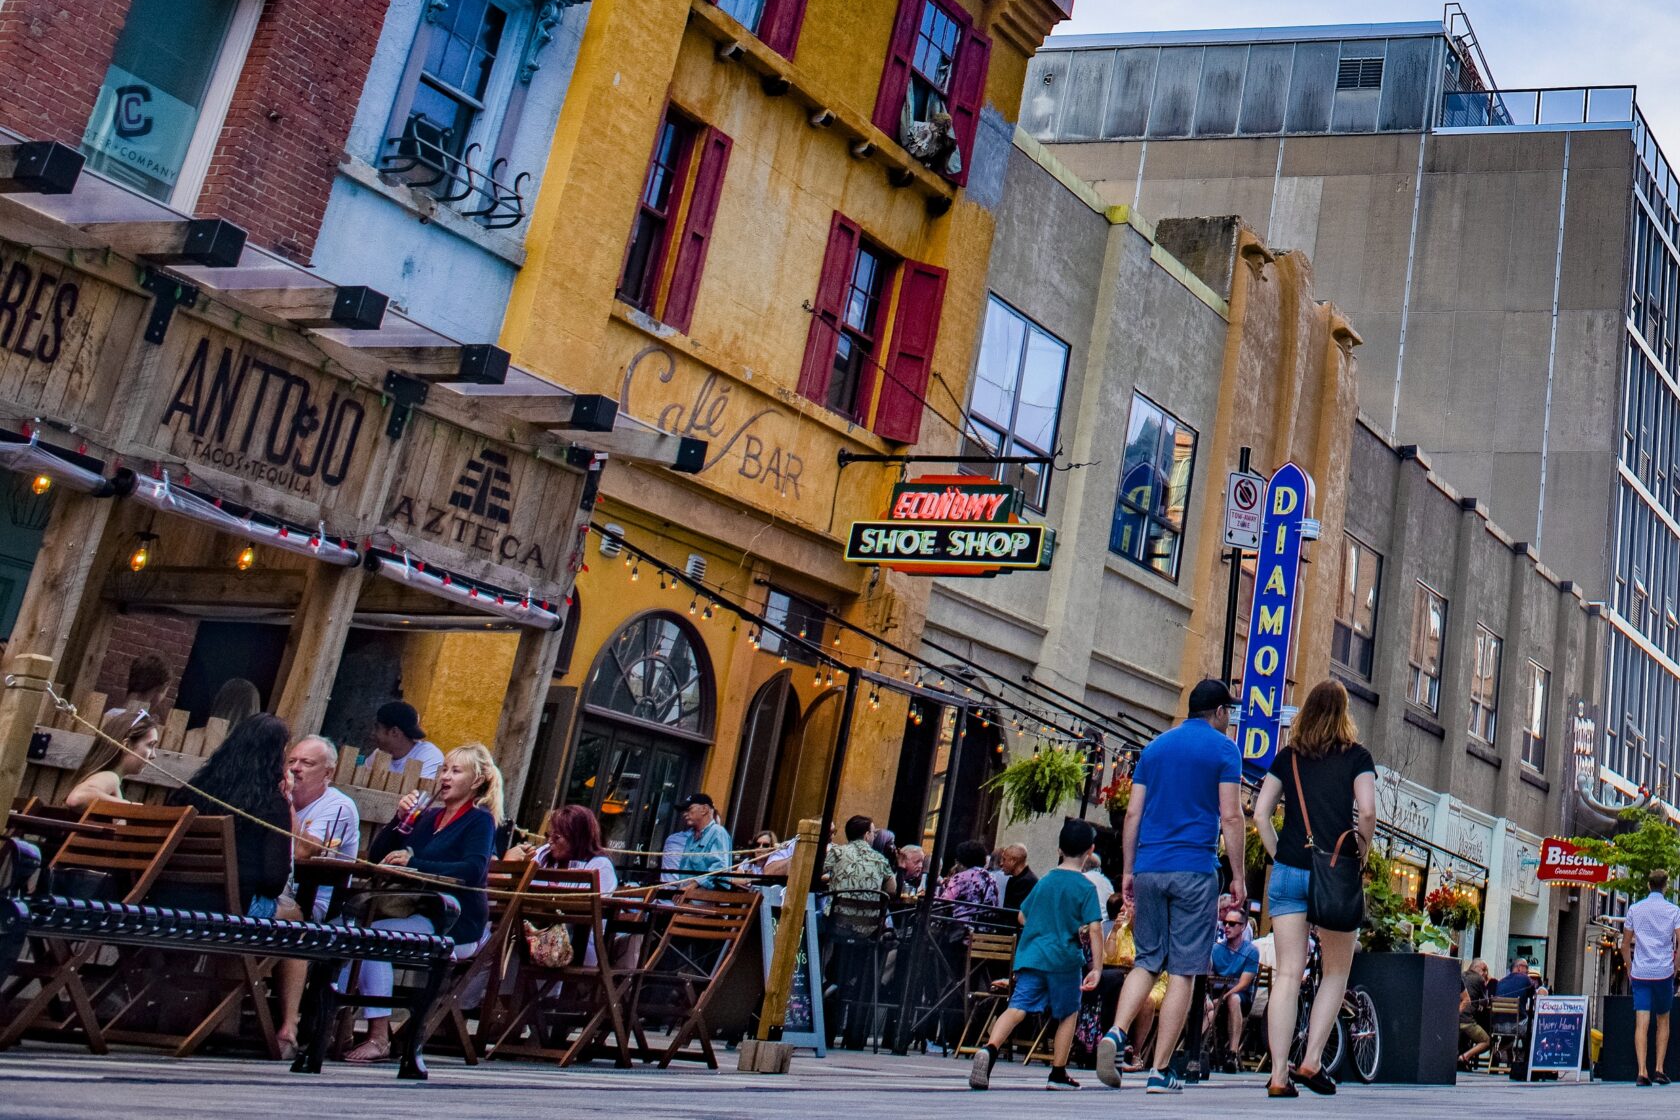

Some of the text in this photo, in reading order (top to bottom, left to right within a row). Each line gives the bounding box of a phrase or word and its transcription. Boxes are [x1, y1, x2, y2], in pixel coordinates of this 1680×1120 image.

[161, 337, 365, 487] ANTOJO
[738, 433, 804, 500] BAR
[893, 491, 1009, 521] ECONOMY
[1232, 511, 1257, 522] TOW-AWAY
[391, 495, 546, 570] AZTECA
[1237, 520, 1250, 529] ZNE
[859, 528, 1031, 558] SHOE SHOP
[1243, 486, 1298, 759] DIAMOND
[1546, 846, 1604, 868] Biscui
